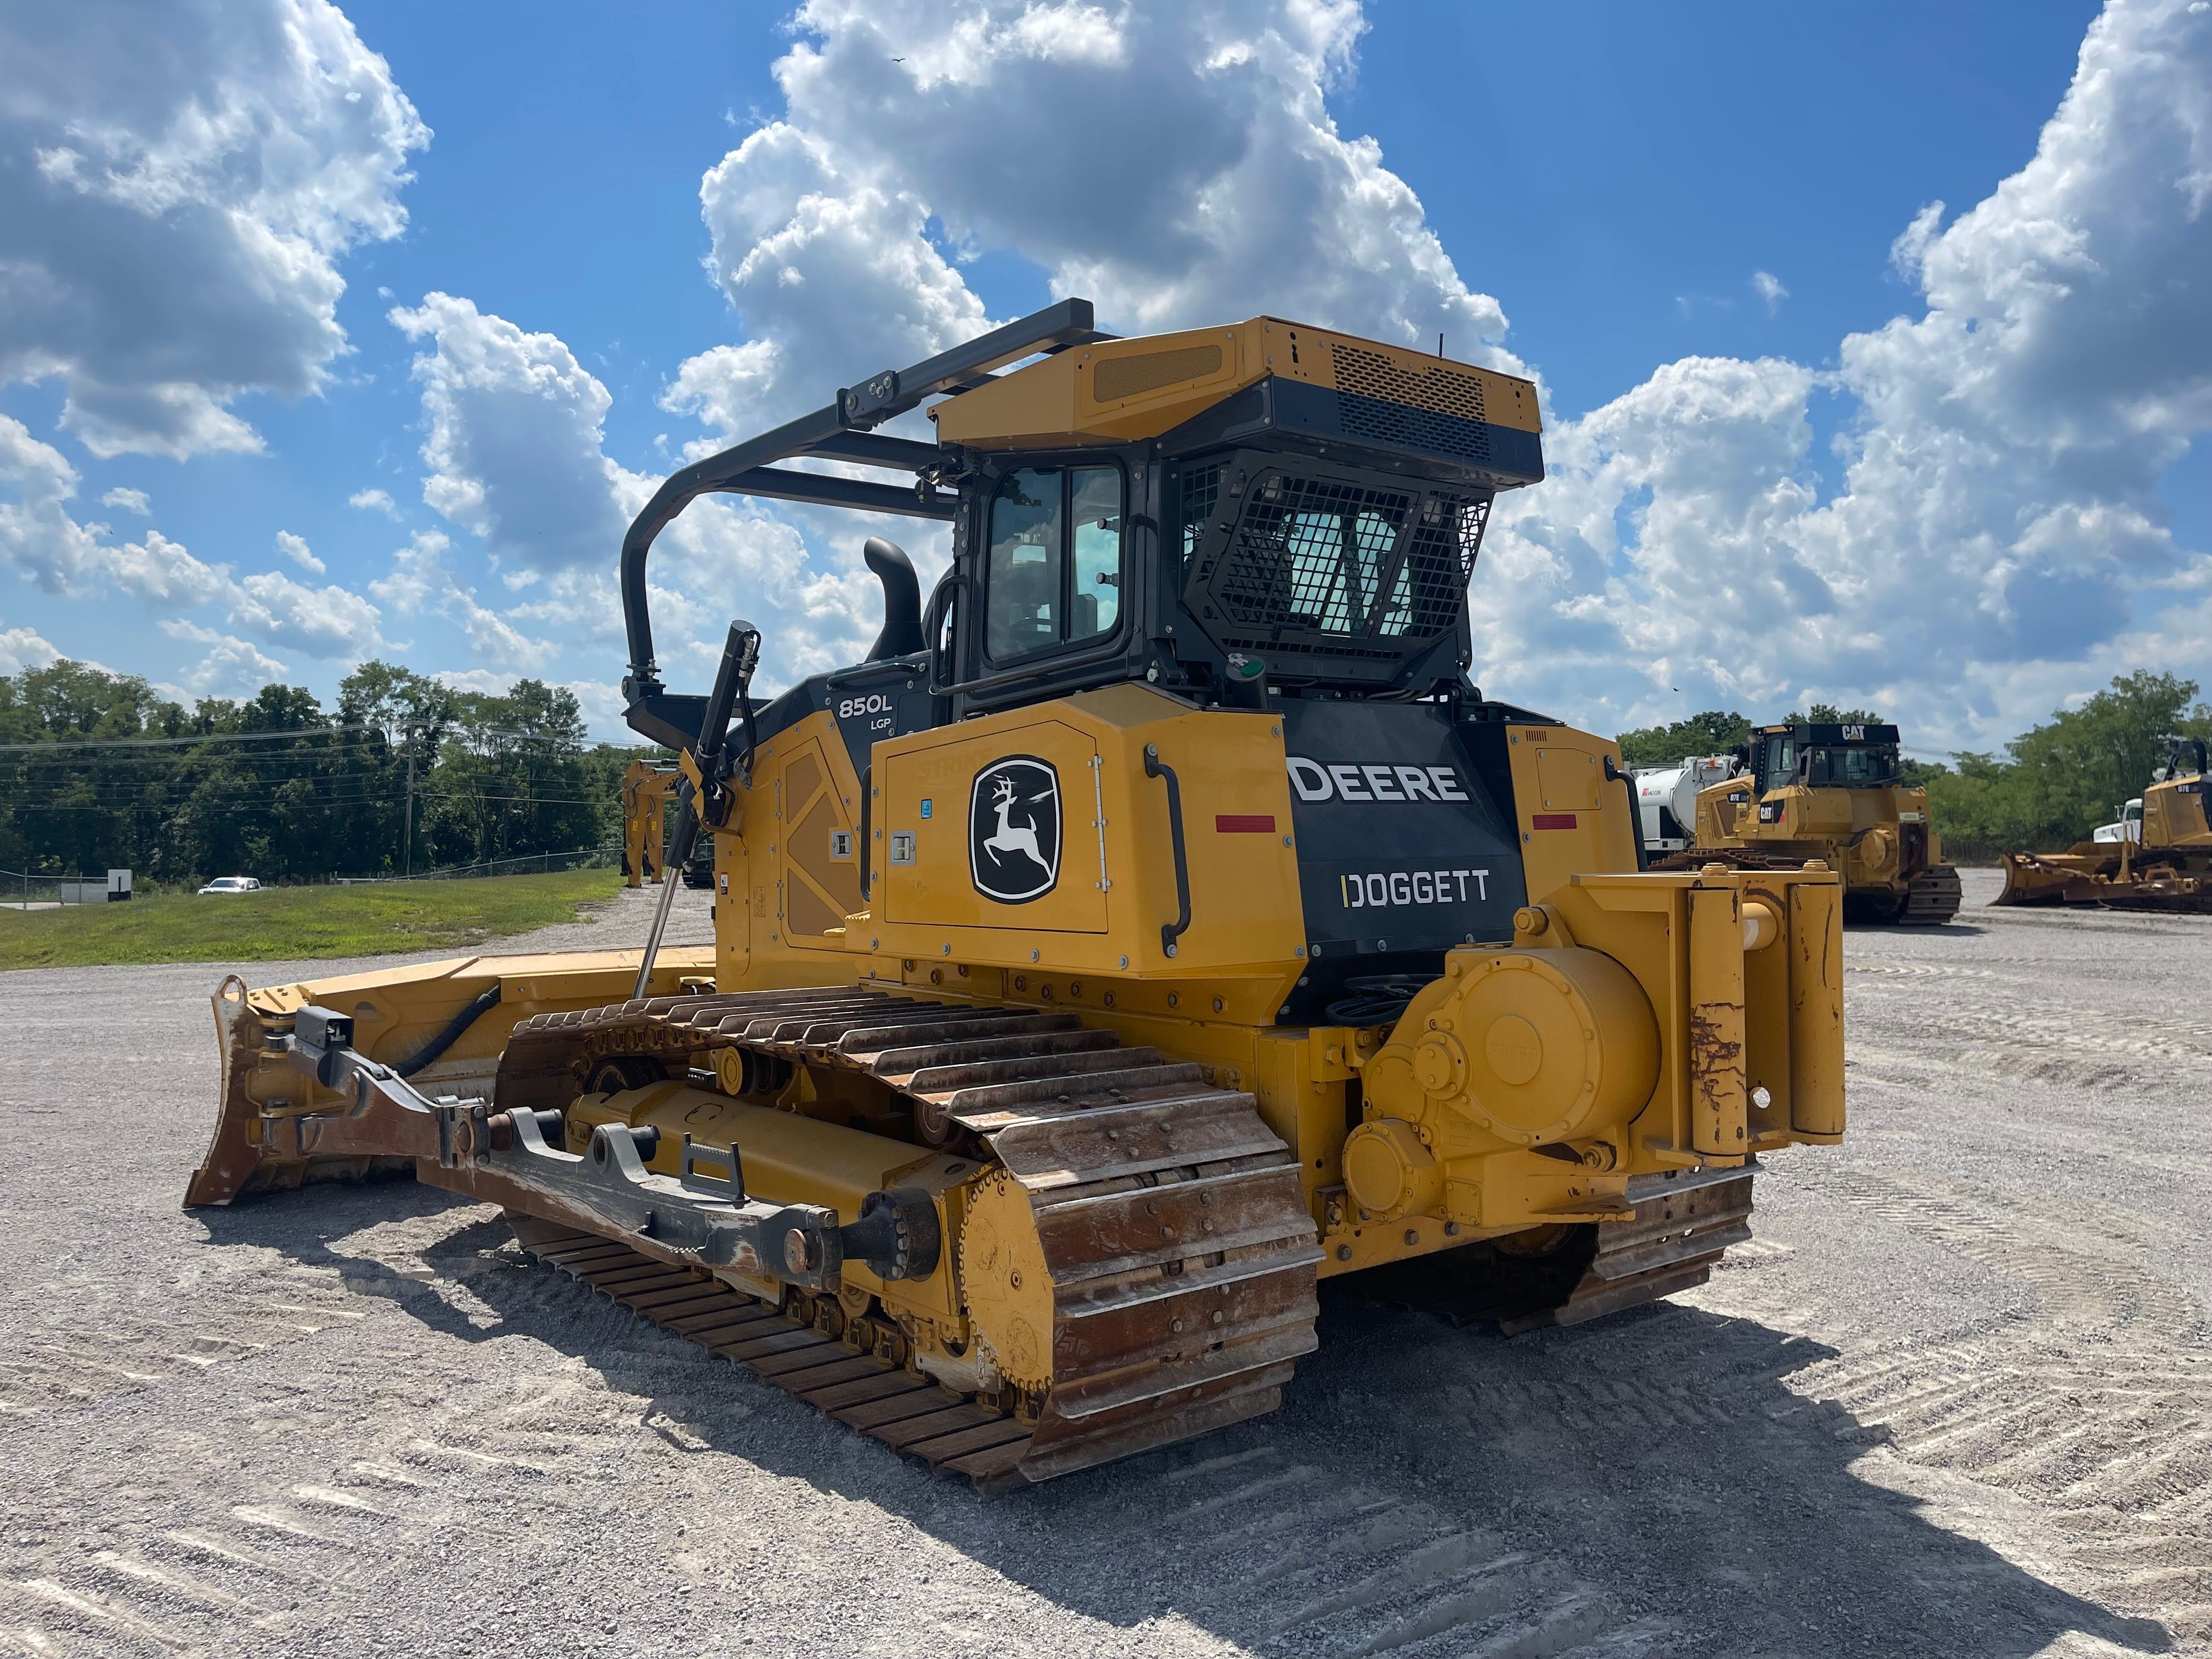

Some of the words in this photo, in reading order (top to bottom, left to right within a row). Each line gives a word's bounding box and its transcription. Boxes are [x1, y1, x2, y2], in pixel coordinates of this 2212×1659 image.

[839, 694, 893, 719] 850L
[871, 718, 891, 730] LGP
[1841, 725, 1865, 741] CAT
[1285, 757, 1470, 801] DEERE
[1730, 793, 1740, 802] D7E
[1760, 806, 1772, 820] CAT
[1340, 869, 1489, 908] DOGGETT
